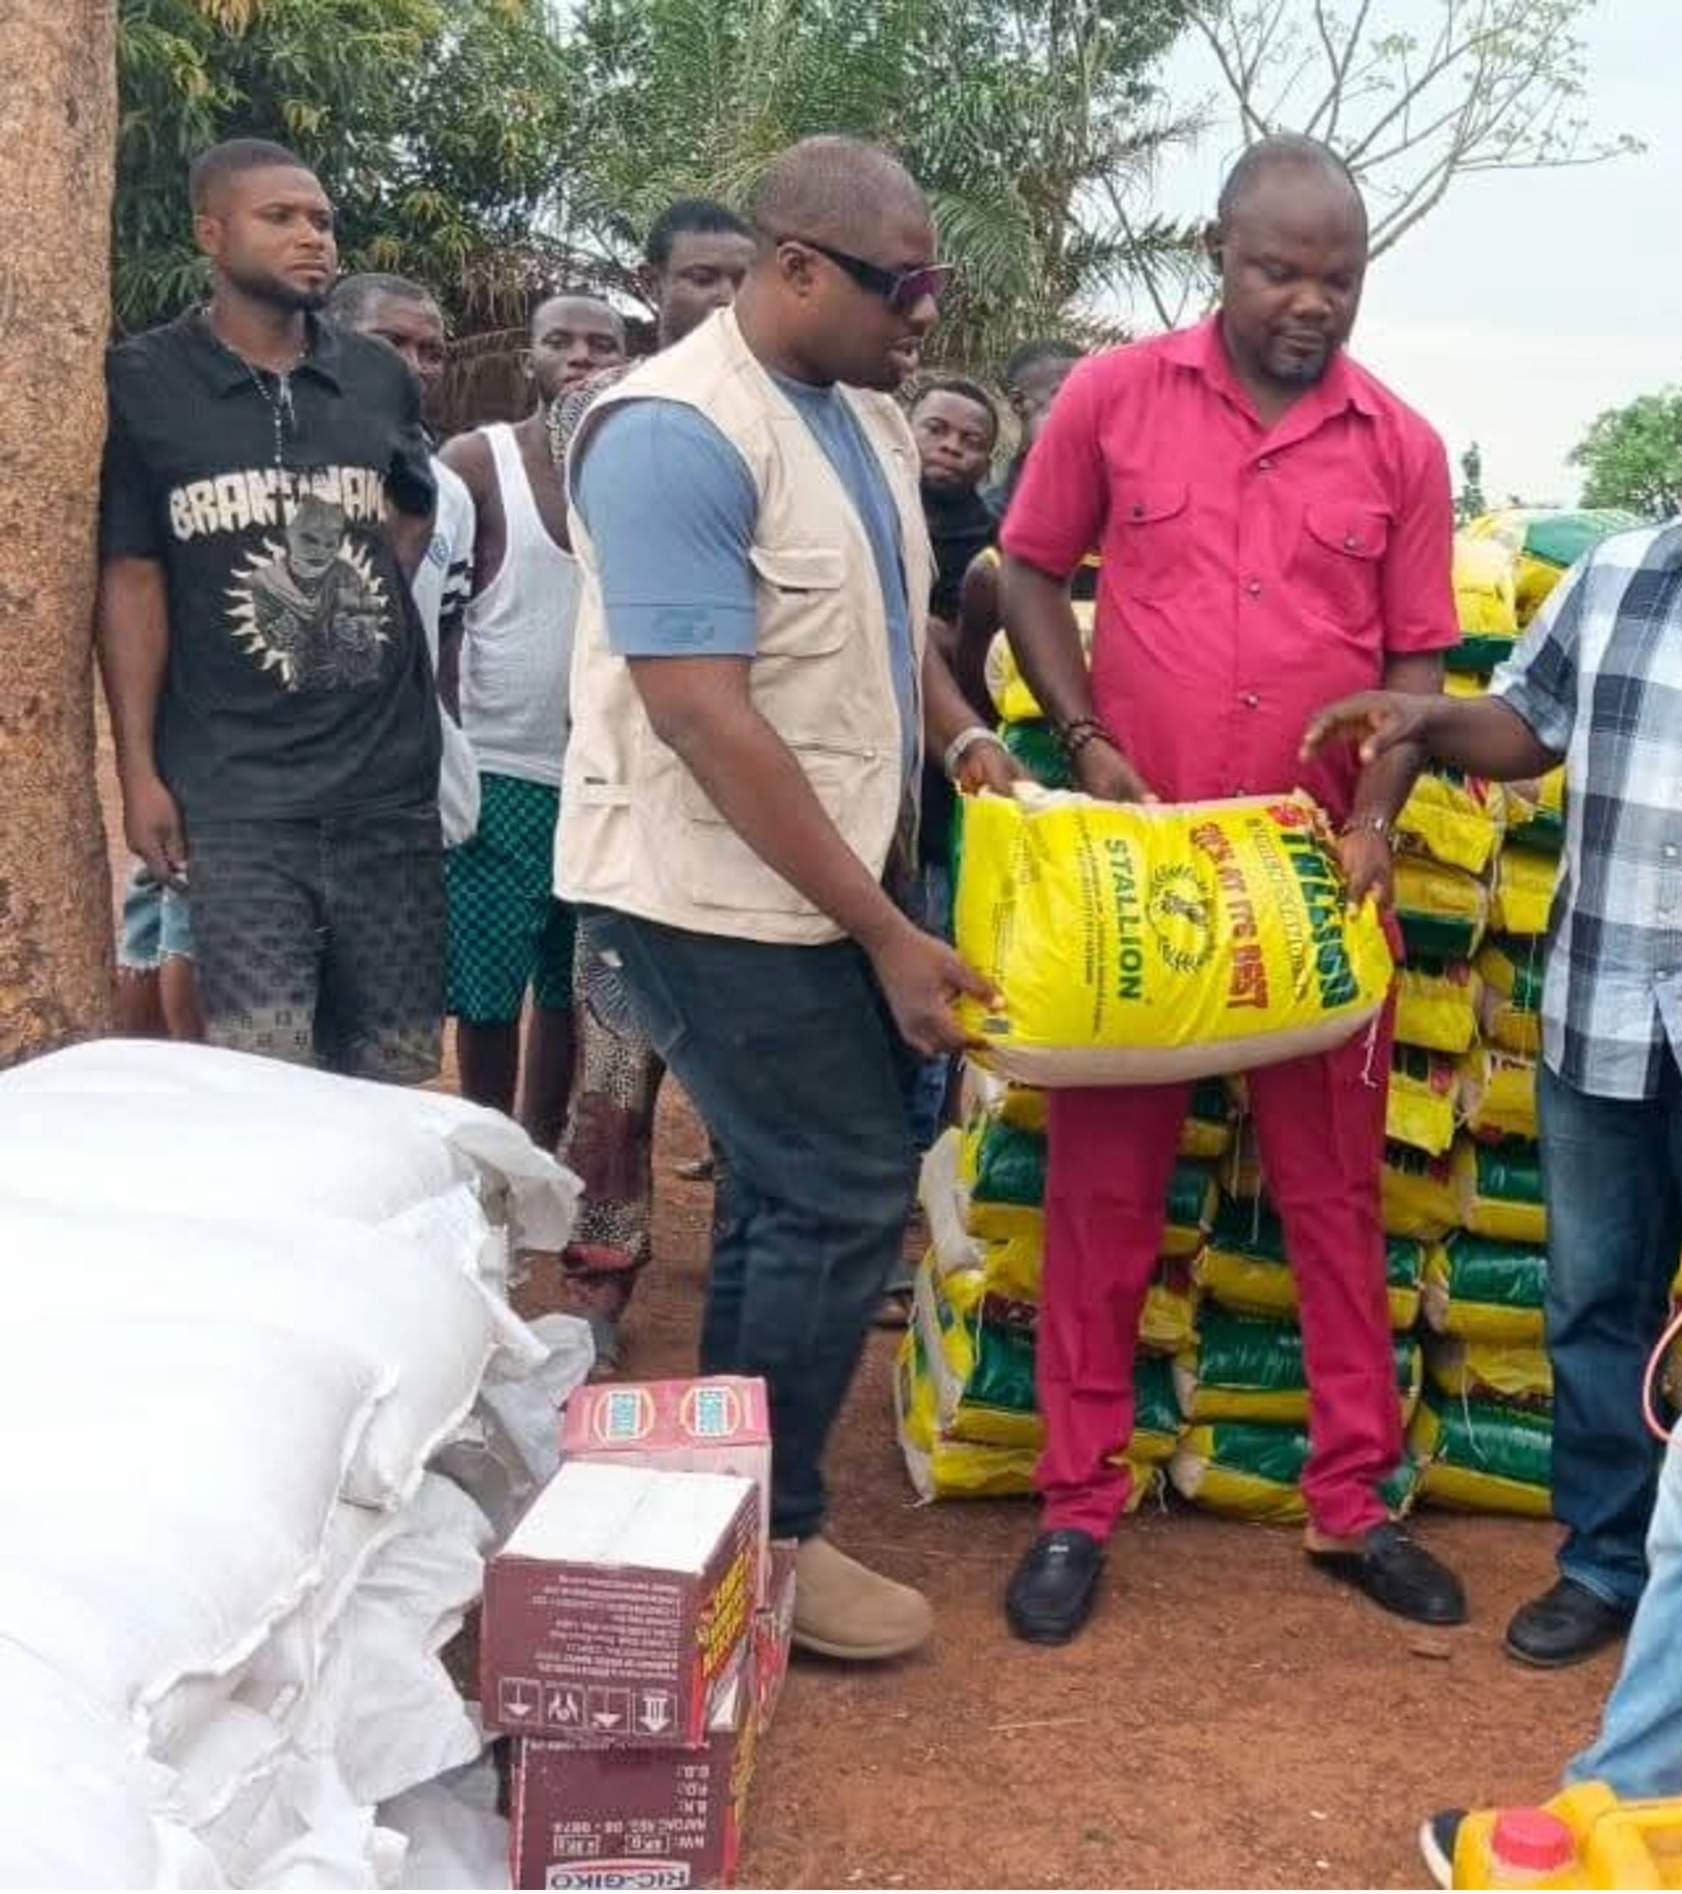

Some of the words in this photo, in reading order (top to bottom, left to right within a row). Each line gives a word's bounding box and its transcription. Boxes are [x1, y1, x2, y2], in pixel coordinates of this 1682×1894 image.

[1104, 838, 1144, 1000] STALLION
[1226, 944, 1269, 1009] BEST
[551, 1871, 687, 1890] RIC-GIKO
